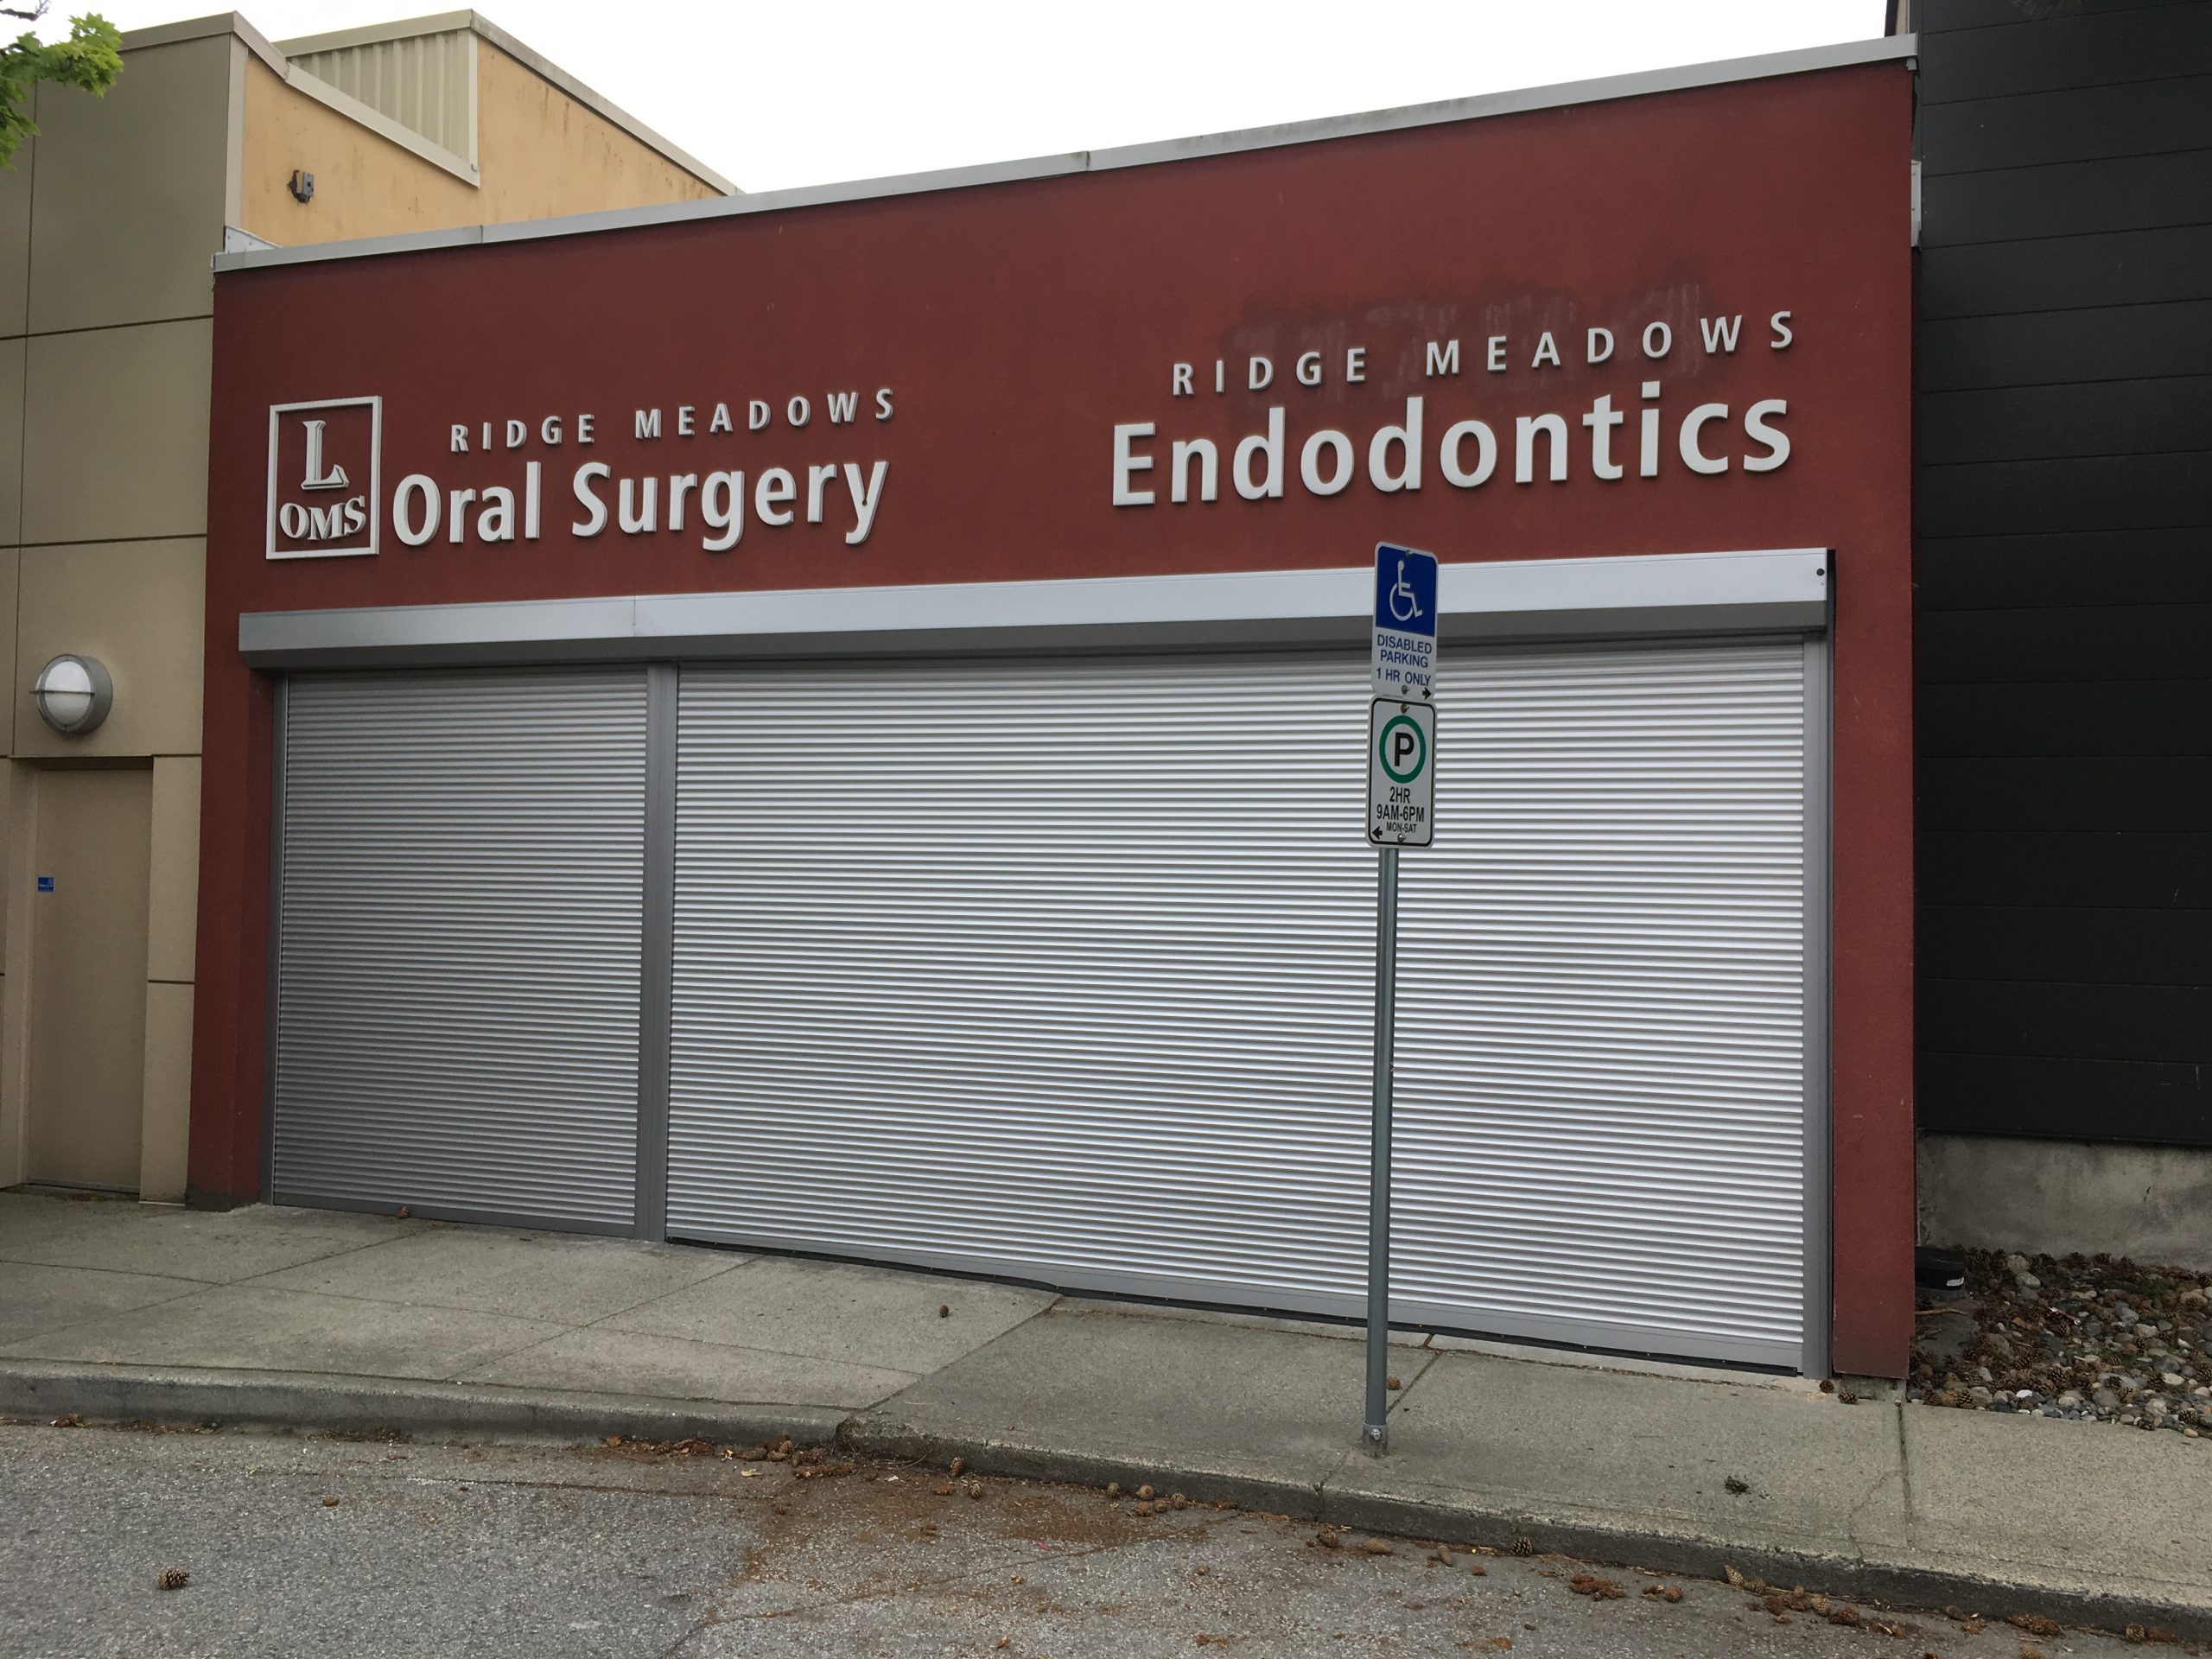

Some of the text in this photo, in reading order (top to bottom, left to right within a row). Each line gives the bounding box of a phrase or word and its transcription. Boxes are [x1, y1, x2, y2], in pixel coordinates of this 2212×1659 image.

[1173, 310, 1795, 397] RIDGE MEADOWS
[450, 388, 894, 453] RIDGE MEADOWS
[301, 420, 350, 491] L
[1112, 381, 1793, 507] Endodontics
[280, 495, 366, 541] OMS
[392, 458, 890, 552] Oral Surgery
[1376, 634, 1433, 654] DISABLED
[1380, 649, 1429, 669] PARKING
[1376, 667, 1432, 687] 1 HR ONLY
[1394, 732, 1414, 767] P
[1389, 786, 1411, 804] 2HR
[1376, 804, 1425, 823] 9AM-6PM
[1386, 821, 1418, 834] MON-SAT
